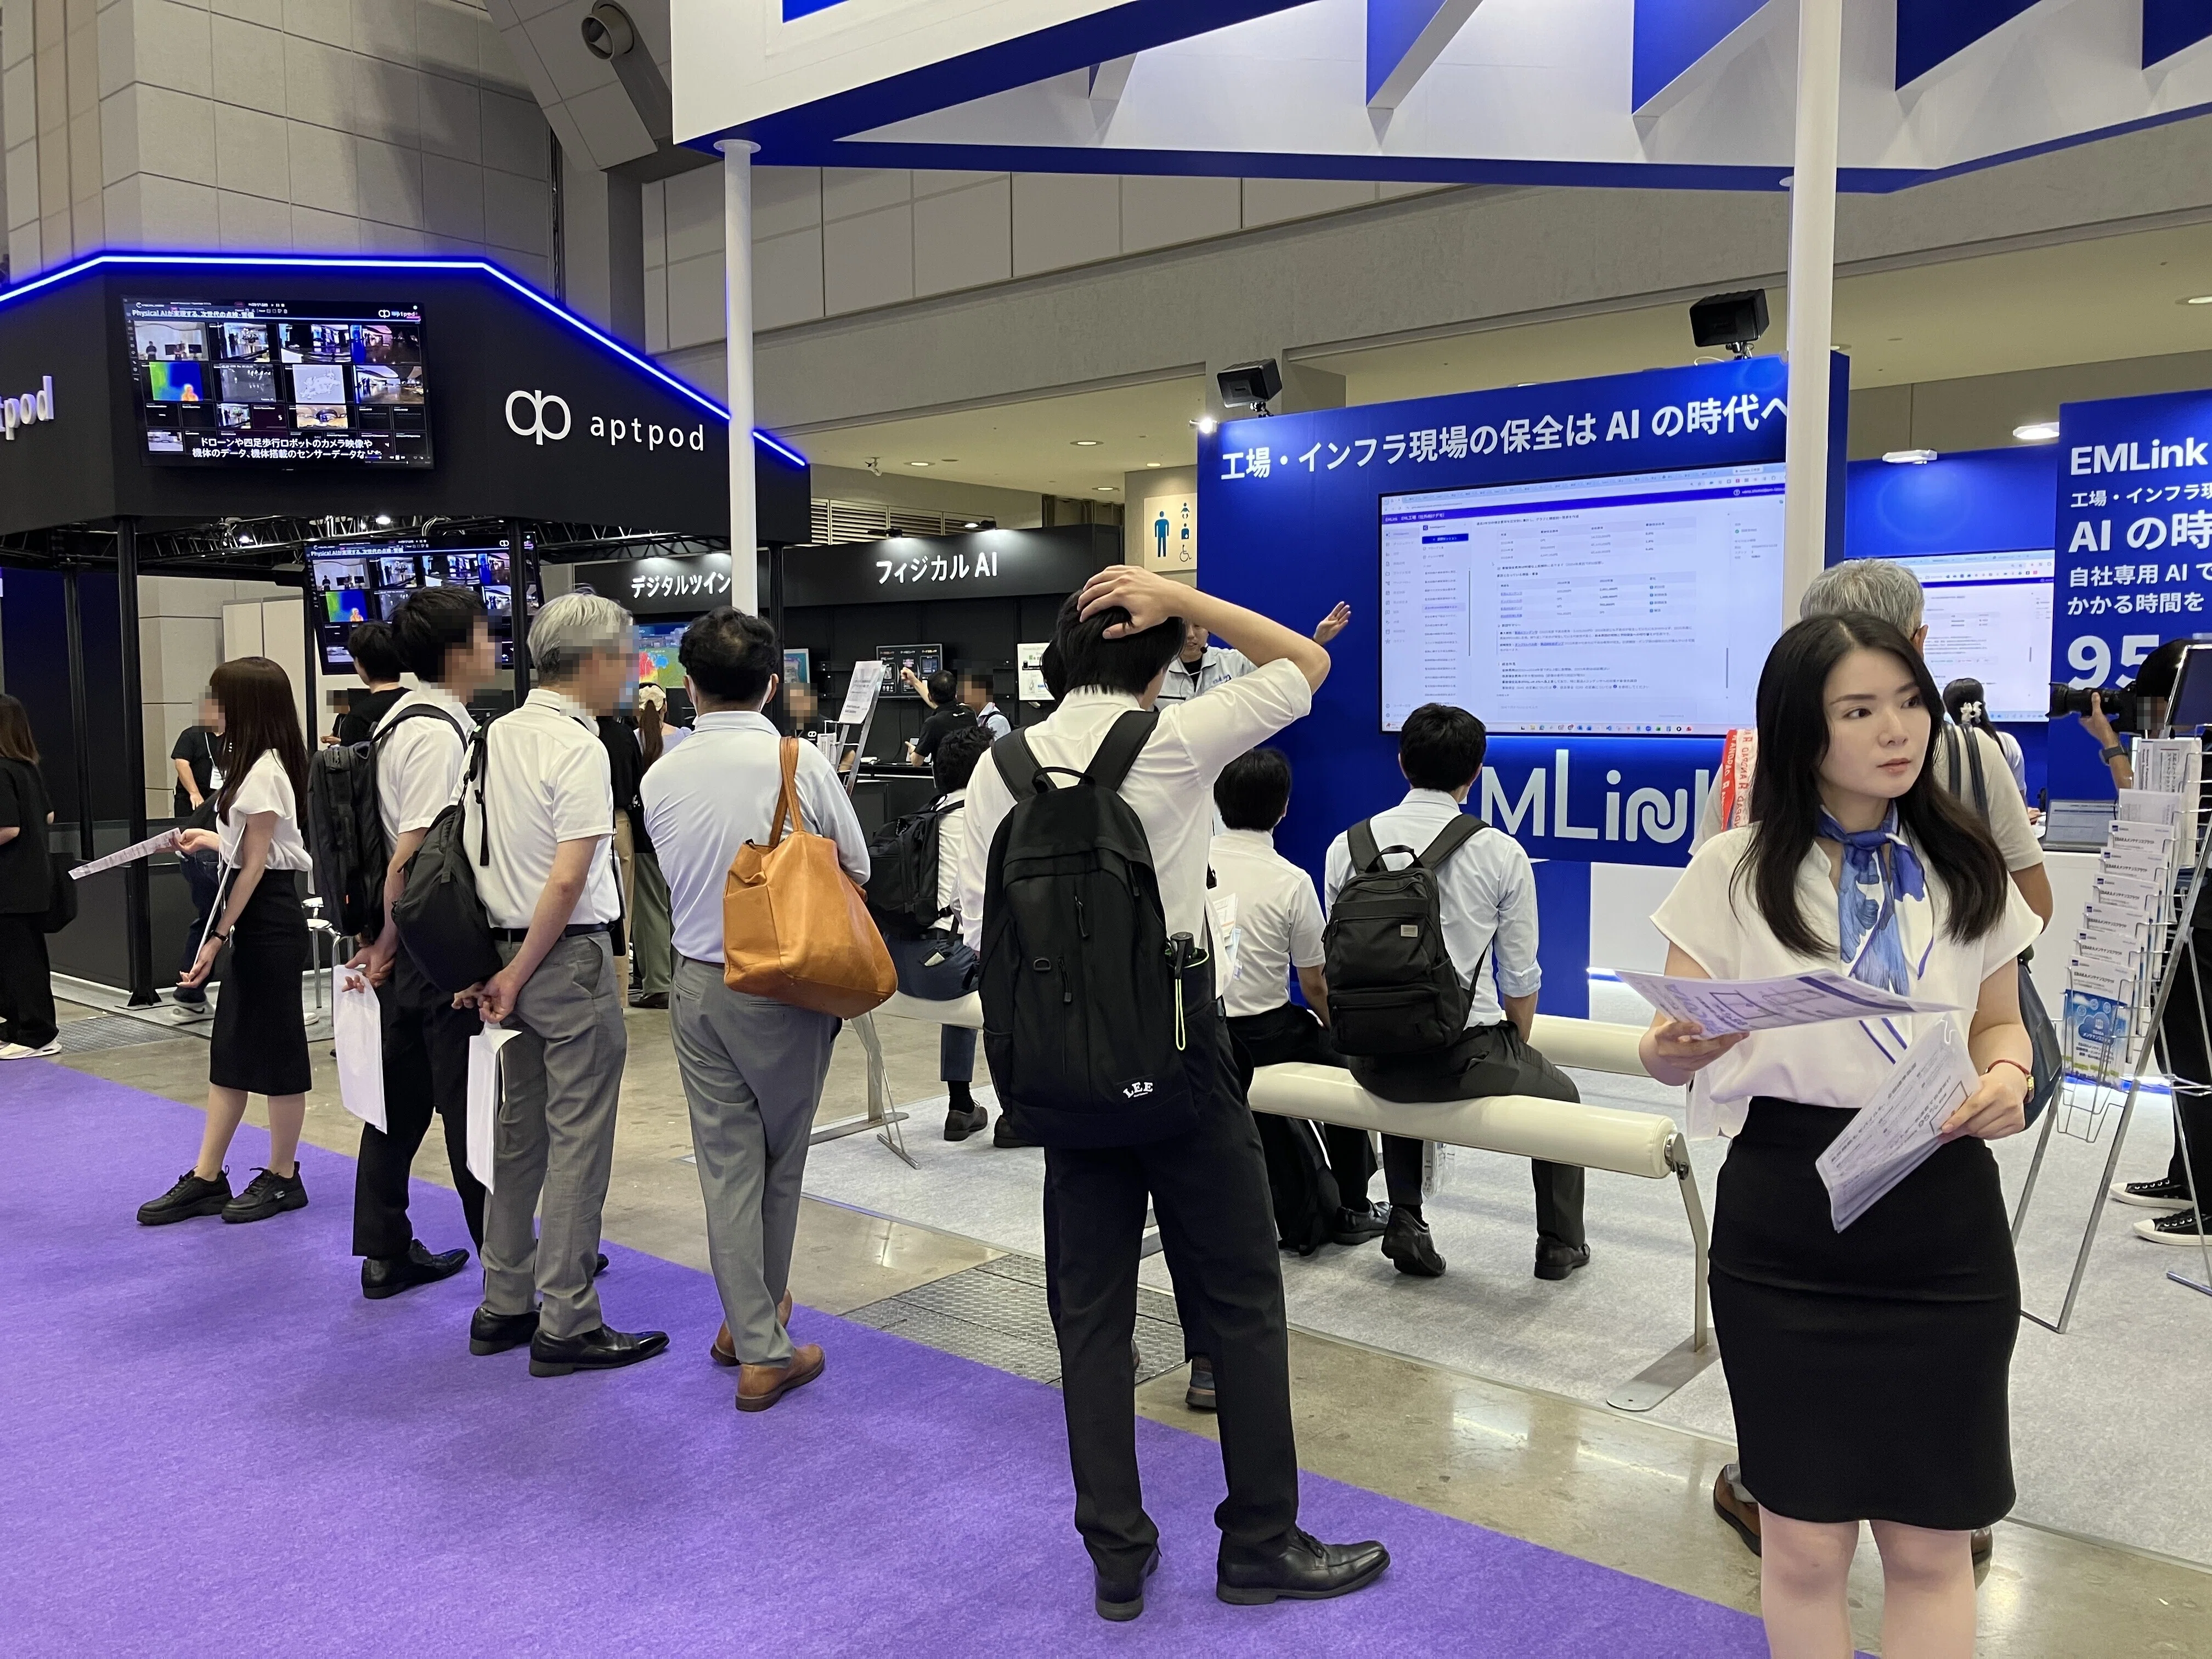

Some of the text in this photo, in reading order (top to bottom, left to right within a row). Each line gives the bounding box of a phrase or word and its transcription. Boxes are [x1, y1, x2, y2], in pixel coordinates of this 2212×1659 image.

[201, 438, 373, 449] ドローンや四足歩行ロボットのカメラ映像や
[590, 415, 704, 452] aptpod
[1221, 393, 1787, 481] 工場・インフラ現場の保全は AI の時代へ
[2070, 437, 2209, 476] EMLink
[2068, 509, 2212, 553] AI の時
[631, 571, 732, 599] デジタルツイン
[876, 551, 998, 585] フィジカル AI
[2069, 564, 2158, 588] 自社専用
[2165, 563, 2188, 582] AI
[2067, 591, 2205, 616] かかる時間を
[1459, 749, 1709, 844] MLin
[1122, 1081, 1153, 1098] LEE
